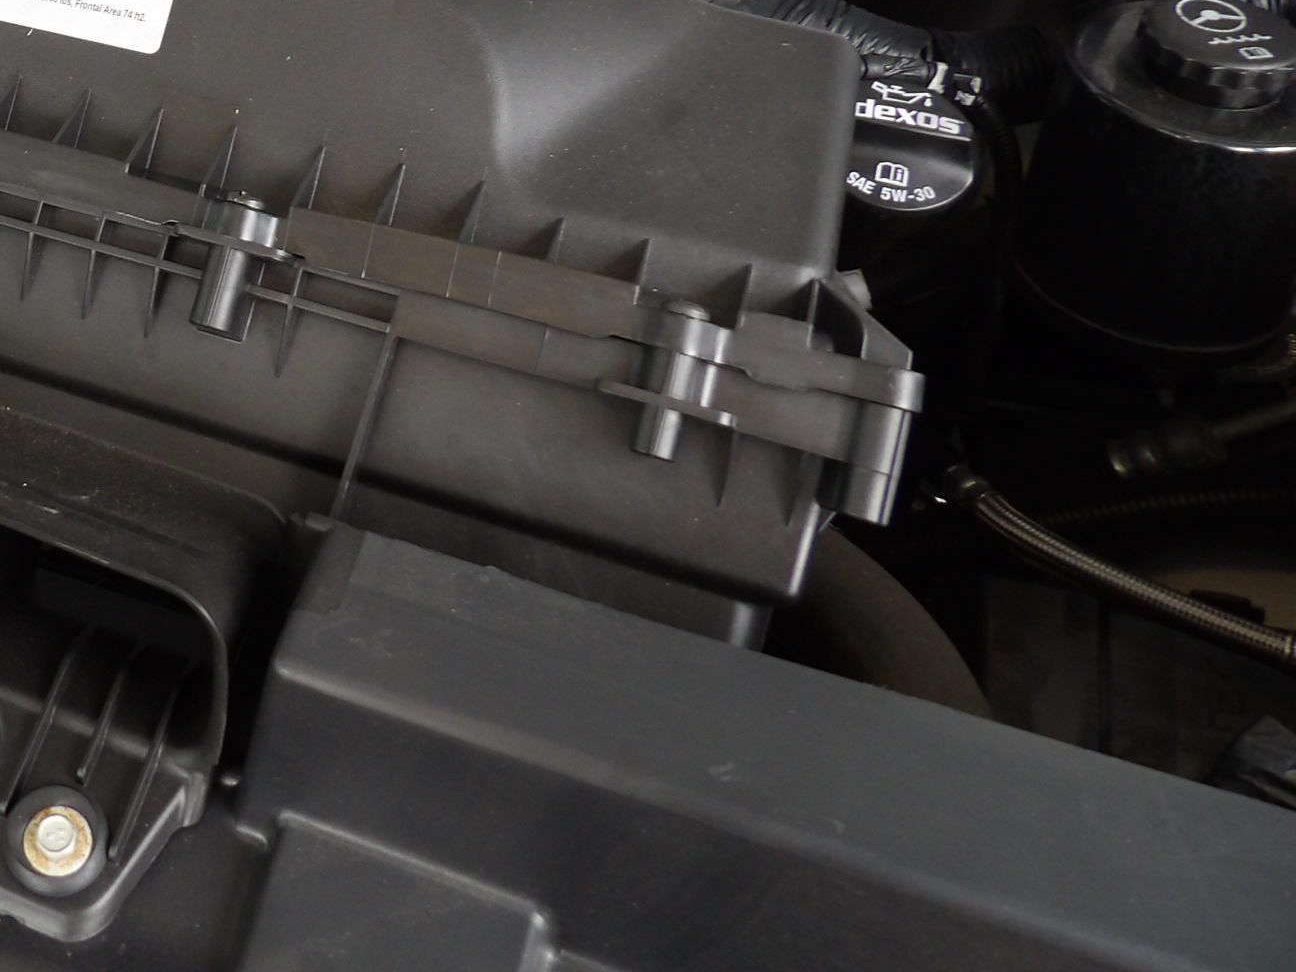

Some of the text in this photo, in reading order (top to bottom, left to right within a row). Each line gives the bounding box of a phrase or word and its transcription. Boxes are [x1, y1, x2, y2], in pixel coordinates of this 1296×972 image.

[103, 5, 122, 17] Area
[123, 9, 134, 19] 74
[855, 99, 965, 135] dexos
[846, 172, 936, 202] SAE 5W-30
